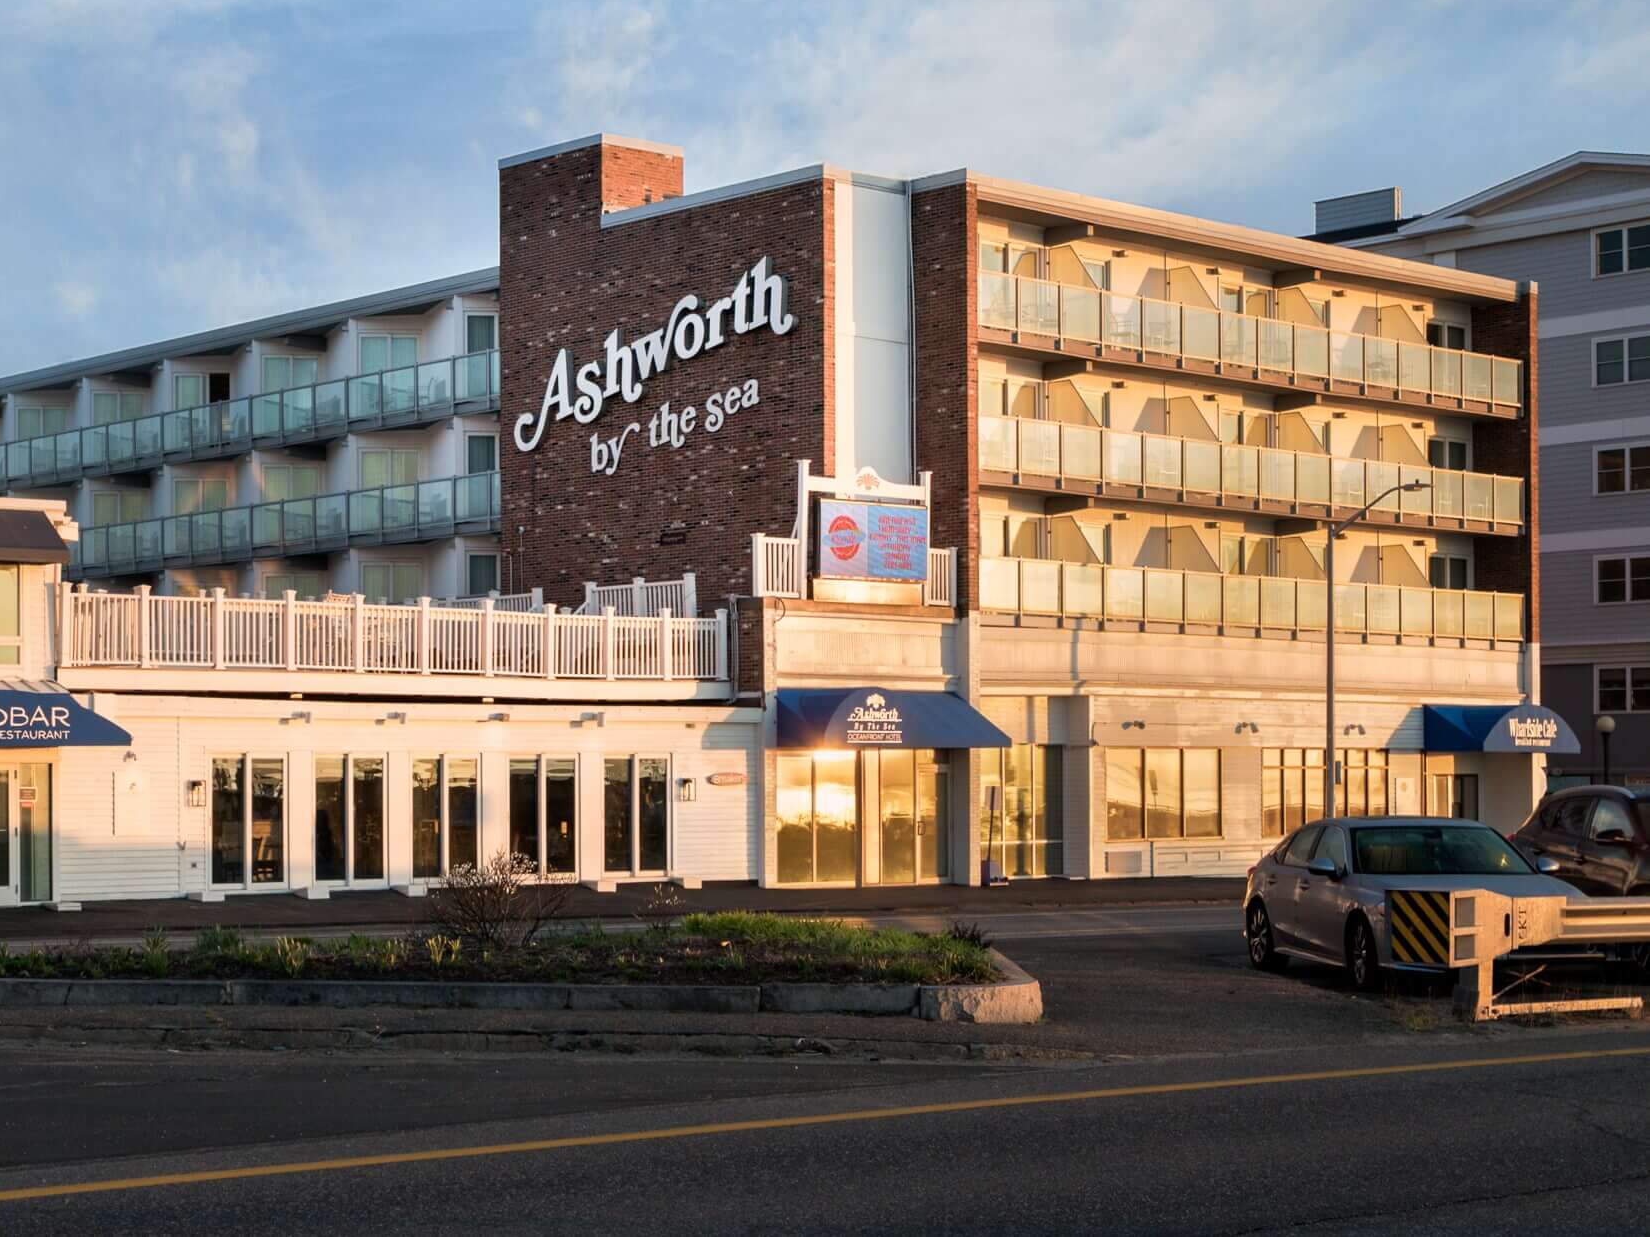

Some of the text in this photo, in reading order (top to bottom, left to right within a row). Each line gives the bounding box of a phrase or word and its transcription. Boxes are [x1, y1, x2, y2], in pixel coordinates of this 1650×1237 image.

[513, 255, 796, 452] Ashworth
[589, 378, 760, 475] by the sea
[850, 707, 899, 722] Ashworth
